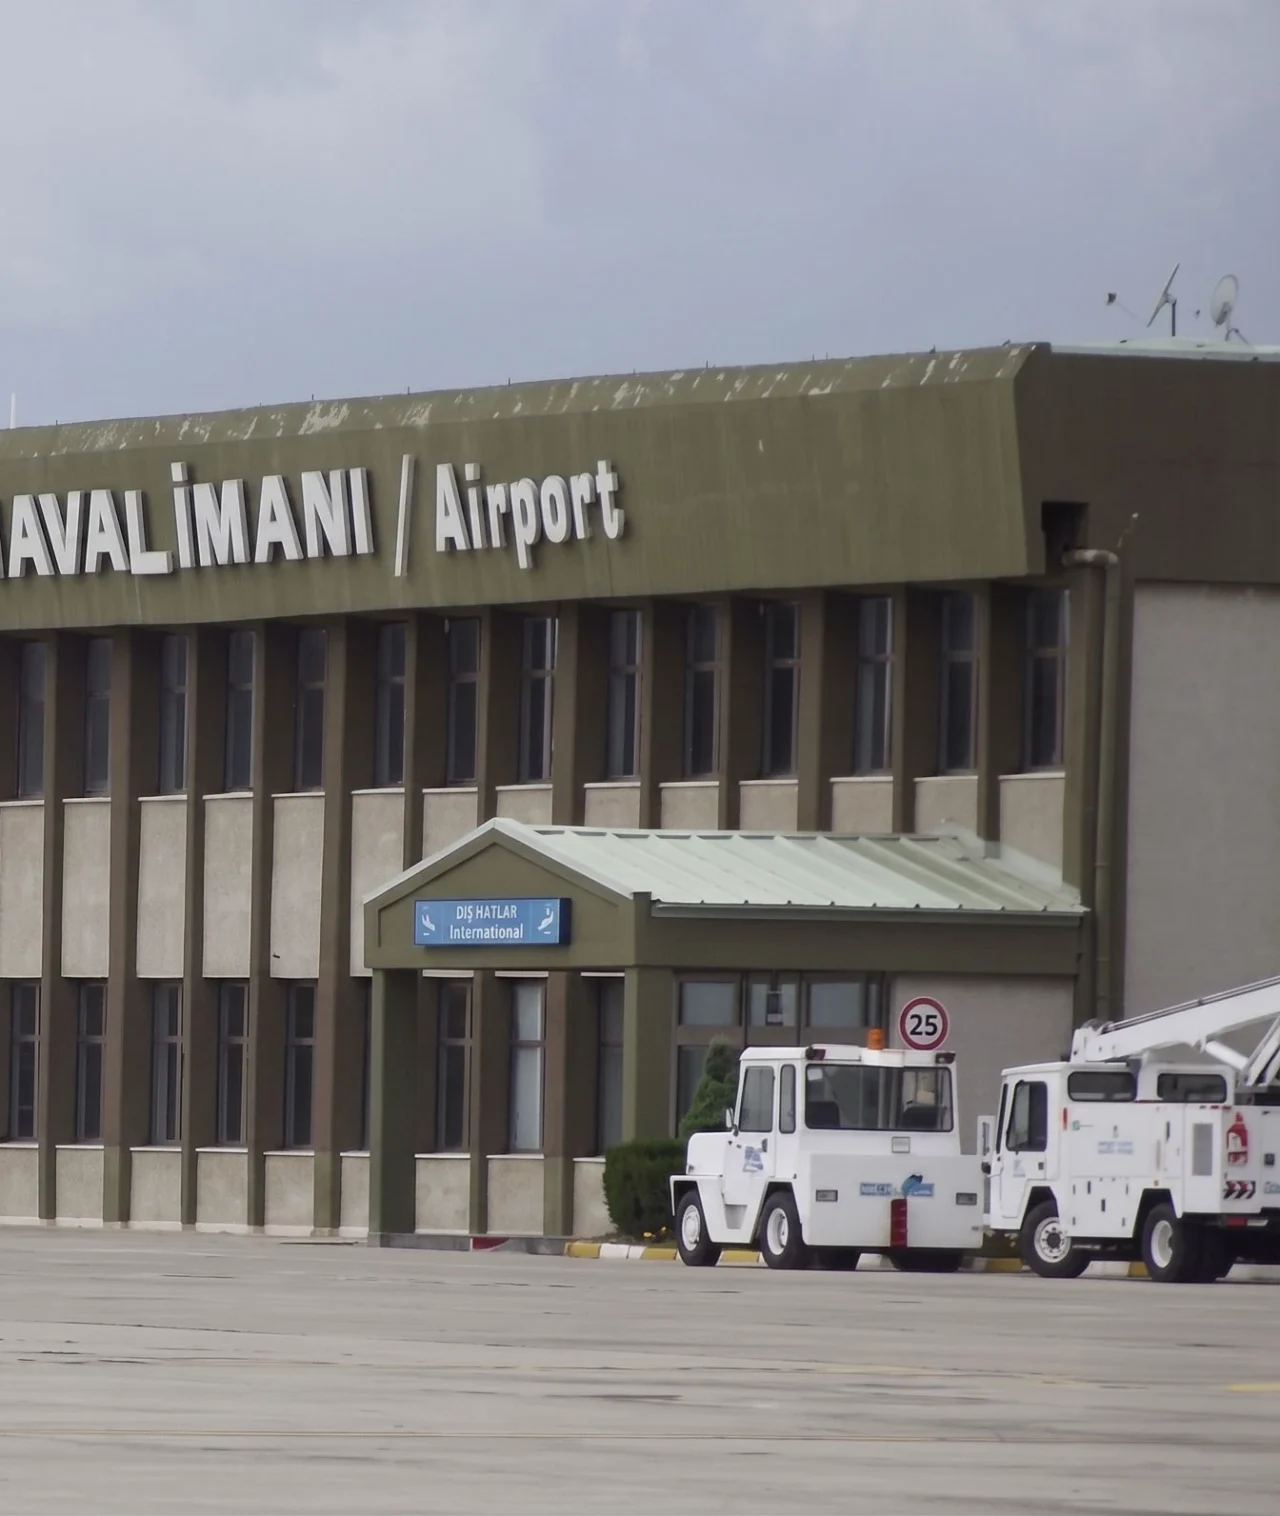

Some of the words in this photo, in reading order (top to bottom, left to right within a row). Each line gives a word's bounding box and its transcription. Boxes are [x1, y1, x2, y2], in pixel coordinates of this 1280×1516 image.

[435, 459, 625, 570] Airport
[456, 905, 473, 923] DIŞ
[475, 905, 518, 919] HATLAR
[449, 923, 524, 940] International
[910, 1013, 938, 1036] 25
